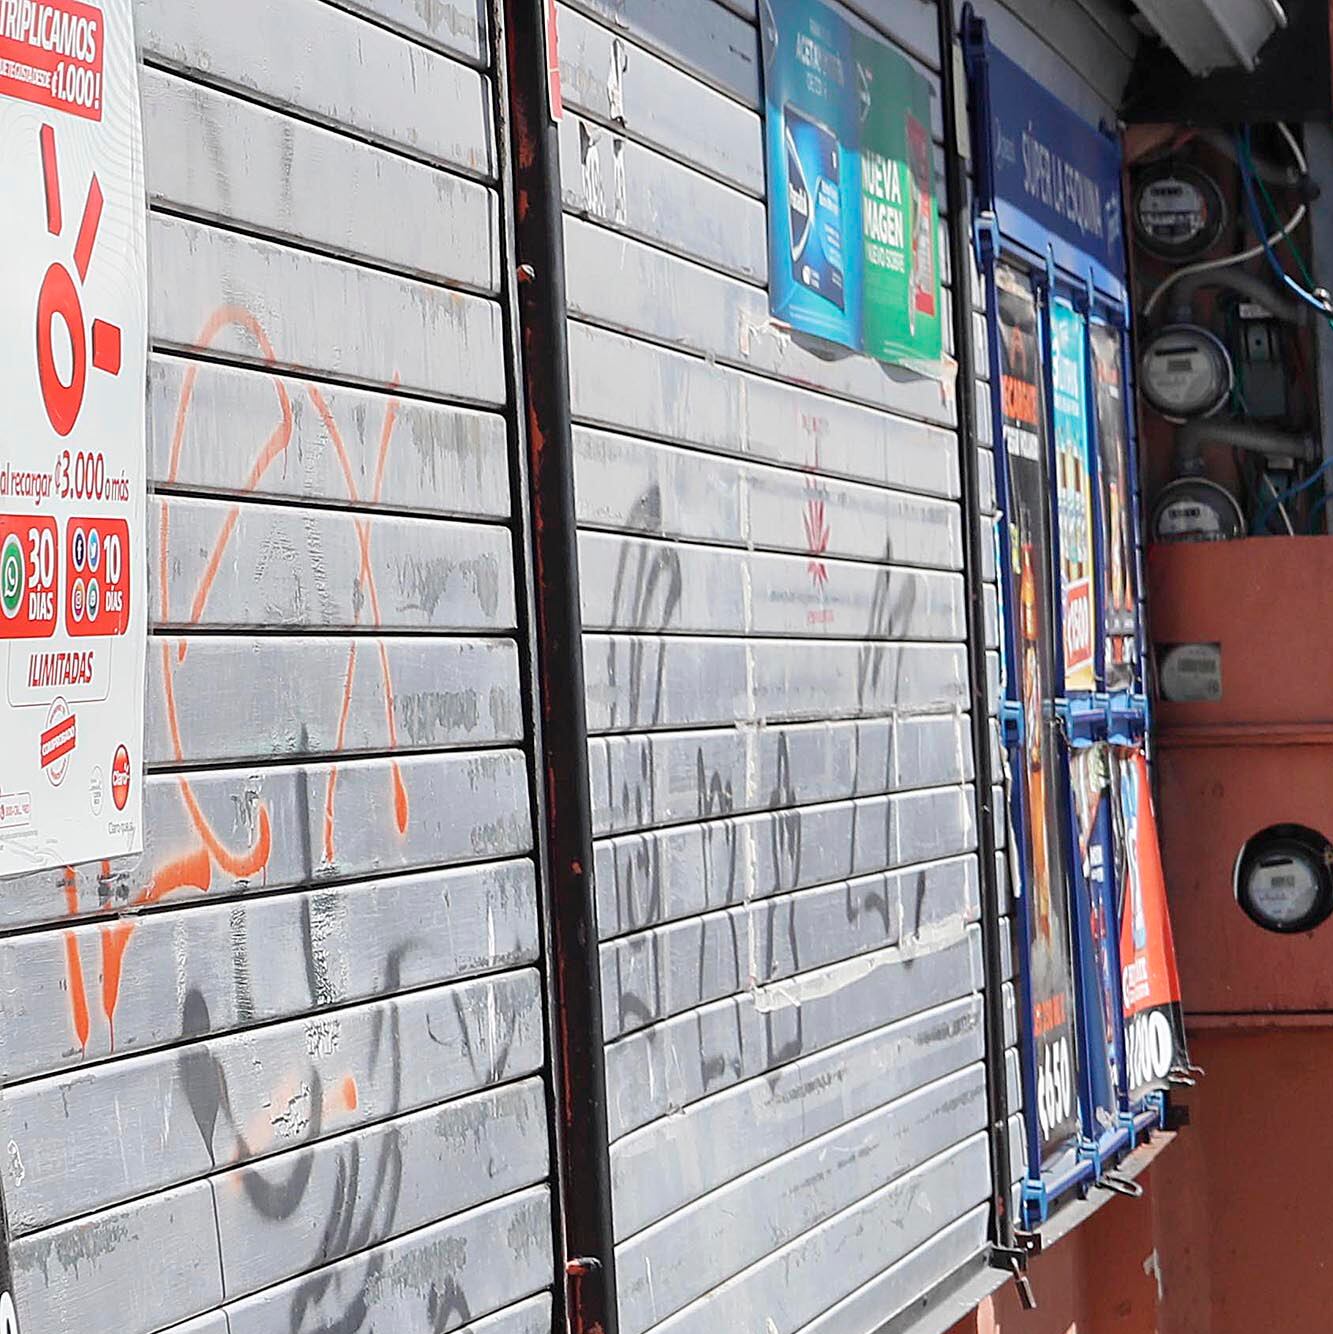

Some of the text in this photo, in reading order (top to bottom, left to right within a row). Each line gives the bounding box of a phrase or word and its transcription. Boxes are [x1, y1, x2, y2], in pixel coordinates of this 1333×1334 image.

[0, 462, 10, 496] al
[11, 472, 52, 505] recargar
[112, 470, 130, 502] más
[28, 527, 55, 588] 30
[103, 534, 122, 585] 10
[29, 584, 54, 621] DÍAS
[105, 585, 123, 612] DÍAS
[28, 651, 94, 688] ILIMITADAS
